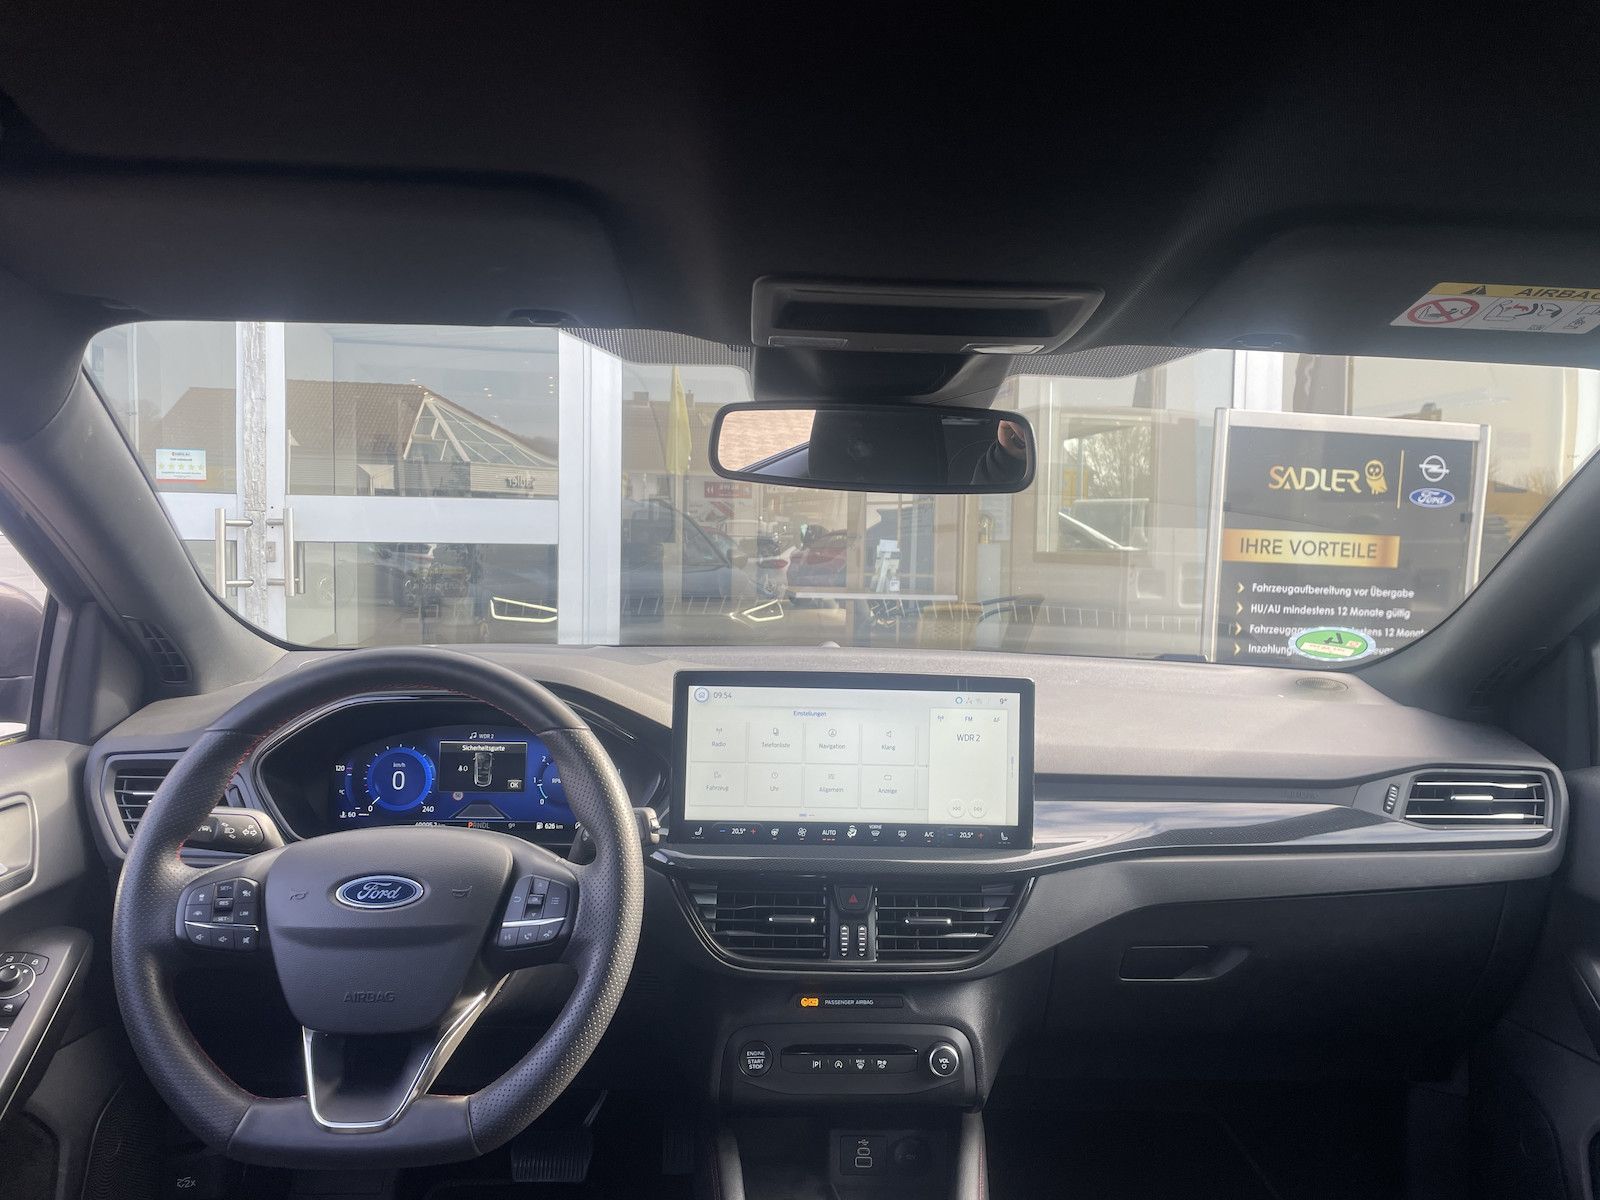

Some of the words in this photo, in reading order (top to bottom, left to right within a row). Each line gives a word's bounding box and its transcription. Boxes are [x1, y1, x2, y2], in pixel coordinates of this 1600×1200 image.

[1268, 465, 1361, 494] SADLER
[1240, 537, 1283, 555] IHRE
[1289, 540, 1377, 559] VORTEILE
[1252, 582, 1352, 598] Fahrzeugaufbereitung
[1353, 587, 1369, 597] vor
[1370, 585, 1415, 600] Übergabe
[1250, 603, 1281, 615] HU/AU
[1283, 604, 1335, 616] mindestens
[1337, 606, 1348, 616] 12
[1349, 606, 1384, 618] Monate
[1385, 607, 1411, 620] gültig
[1384, 627, 1395, 637] 12
[956, 734, 975, 742] WDR
[461, 744, 505, 752] Sicherheitsgurte
[818, 743, 846, 751] Navigation
[392, 770, 405, 790] 0
[357, 881, 401, 900] Ford
[343, 990, 396, 1002] AIRBAG
